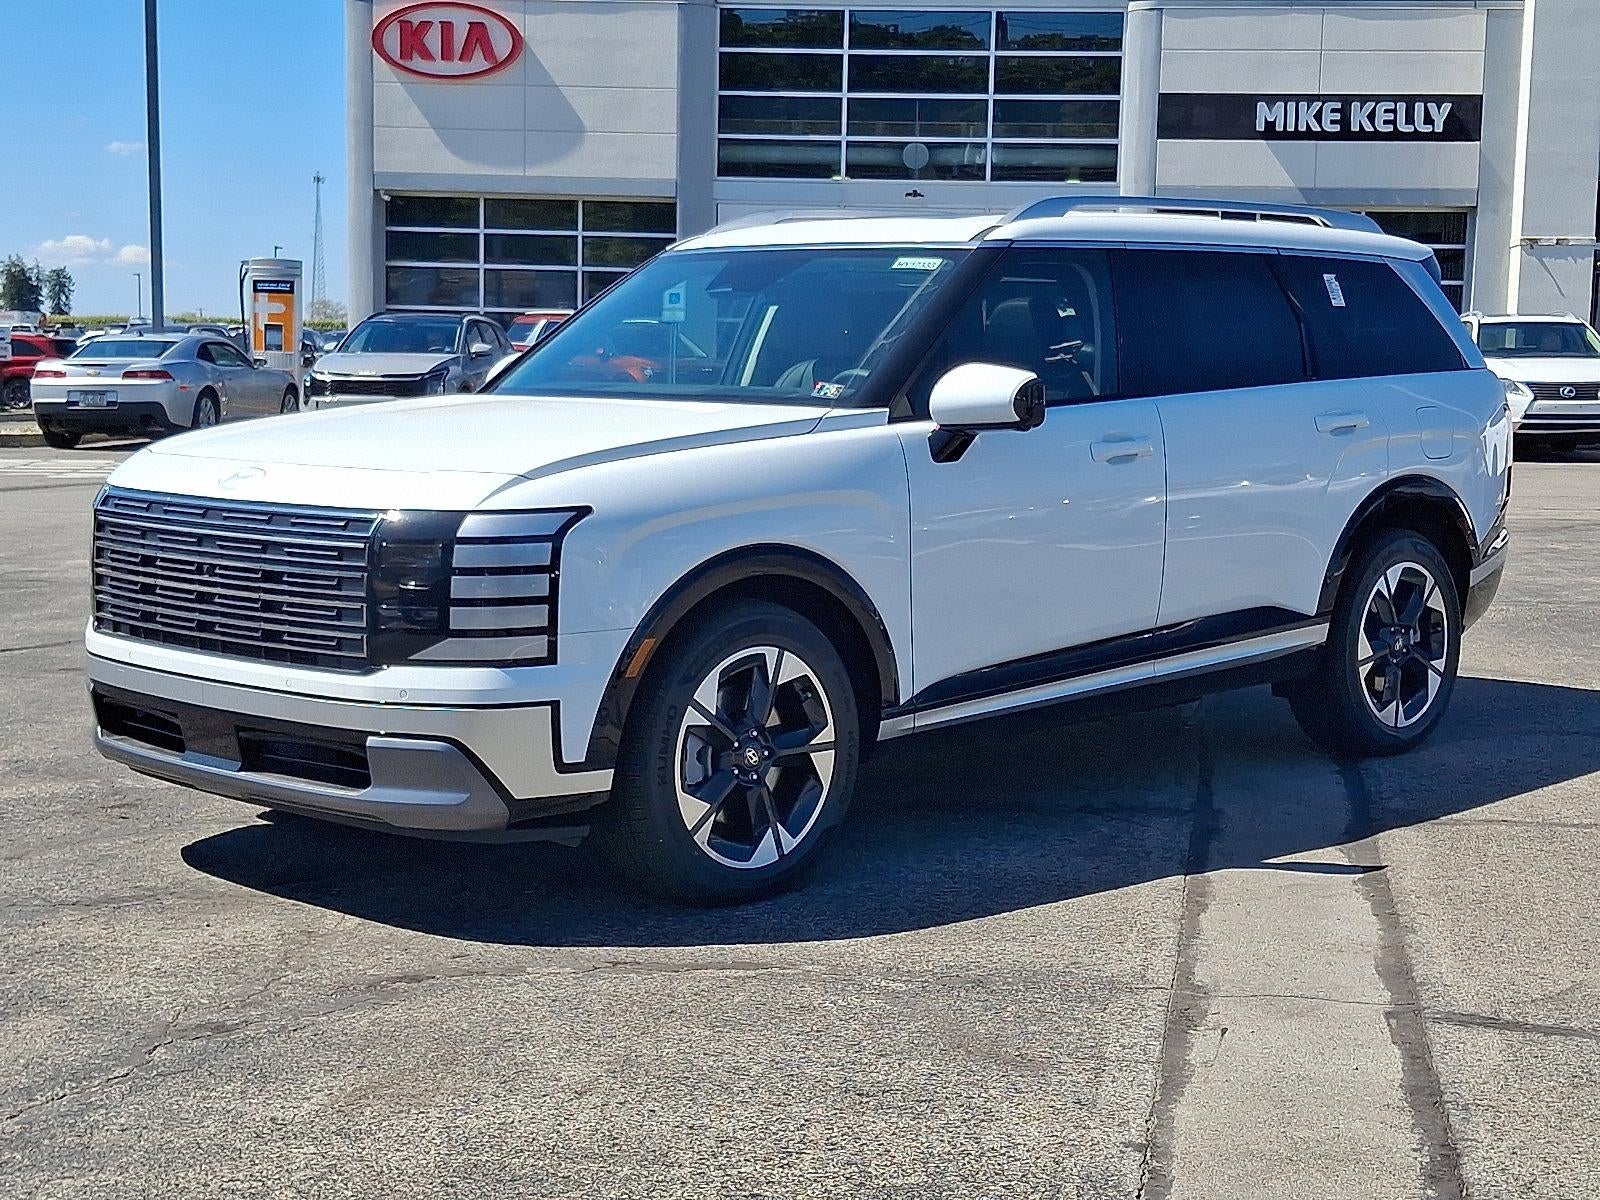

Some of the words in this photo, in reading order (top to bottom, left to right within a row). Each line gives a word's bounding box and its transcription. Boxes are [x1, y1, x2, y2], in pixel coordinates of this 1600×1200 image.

[397, 20, 498, 64] KIA
[1255, 101, 1342, 132] MIKE
[1350, 101, 1453, 133] KELLY
